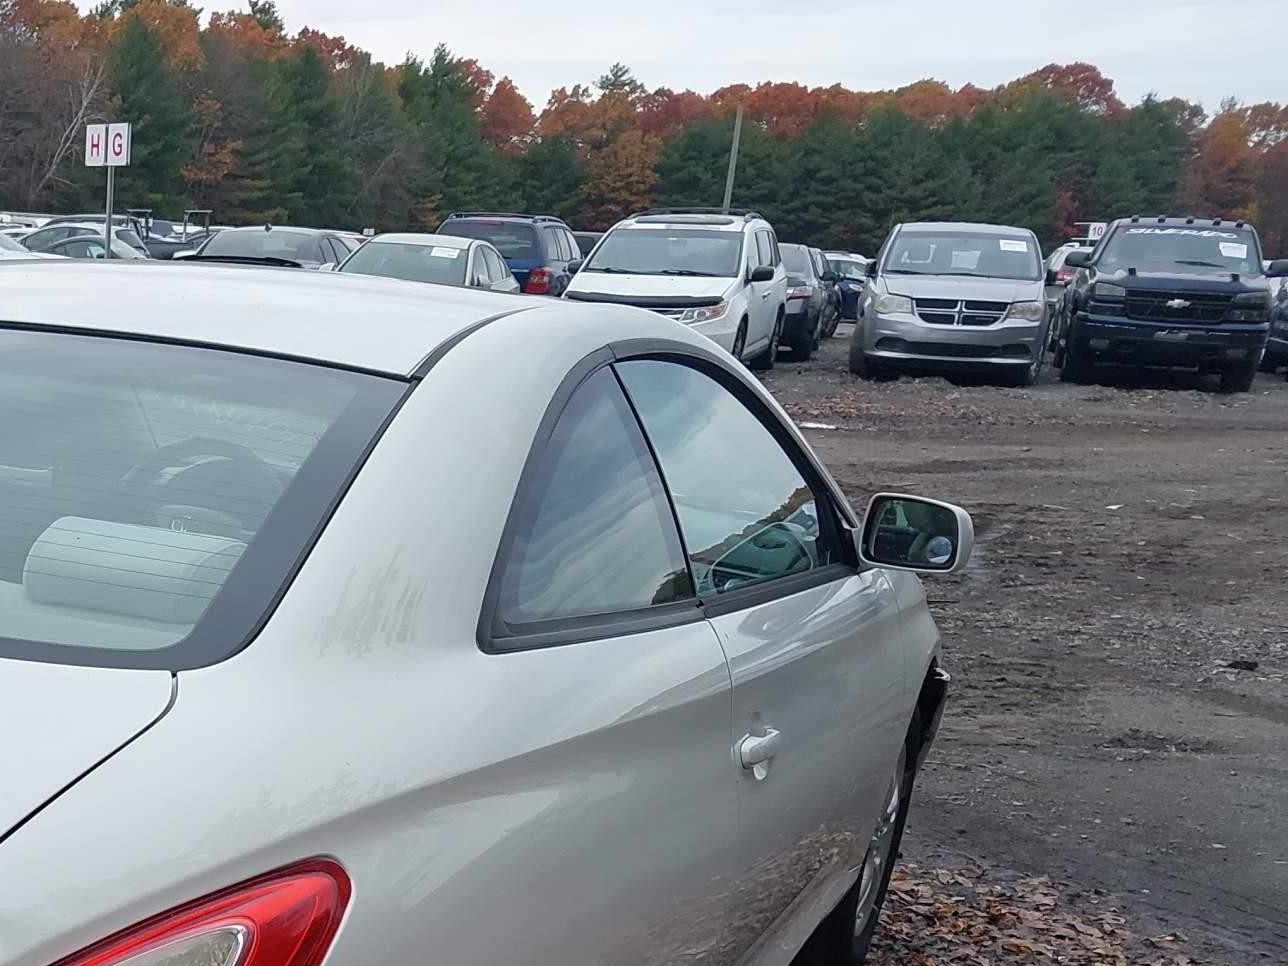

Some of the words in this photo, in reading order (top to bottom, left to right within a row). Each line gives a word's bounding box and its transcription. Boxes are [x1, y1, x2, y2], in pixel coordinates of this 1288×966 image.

[90, 133, 100, 157] H
[112, 132, 123, 157] G
[1092, 226, 1104, 237] 10
[1125, 228, 1238, 239] SILVERADO
